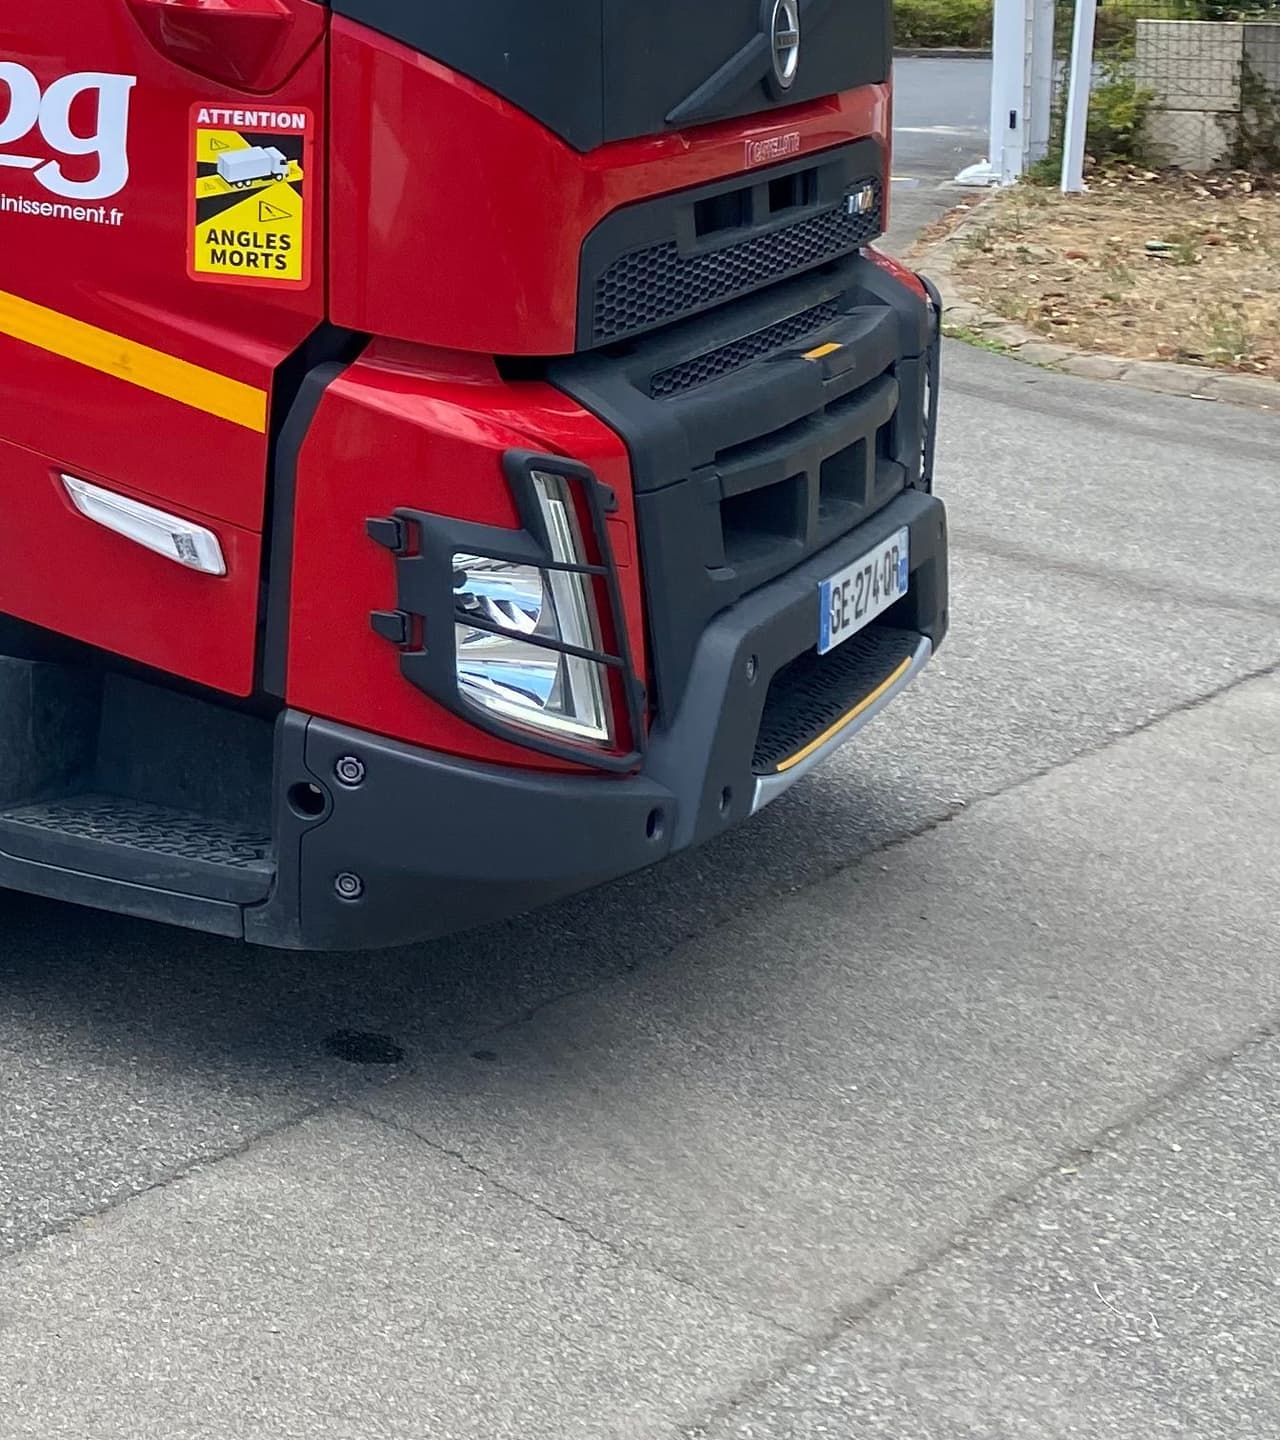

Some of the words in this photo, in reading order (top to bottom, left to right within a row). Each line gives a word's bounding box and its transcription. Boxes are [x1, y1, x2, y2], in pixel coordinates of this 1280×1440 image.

[197, 108, 305, 129] ATTENTION
[205, 228, 291, 251] ANGLES
[211, 248, 287, 270] MORTS
